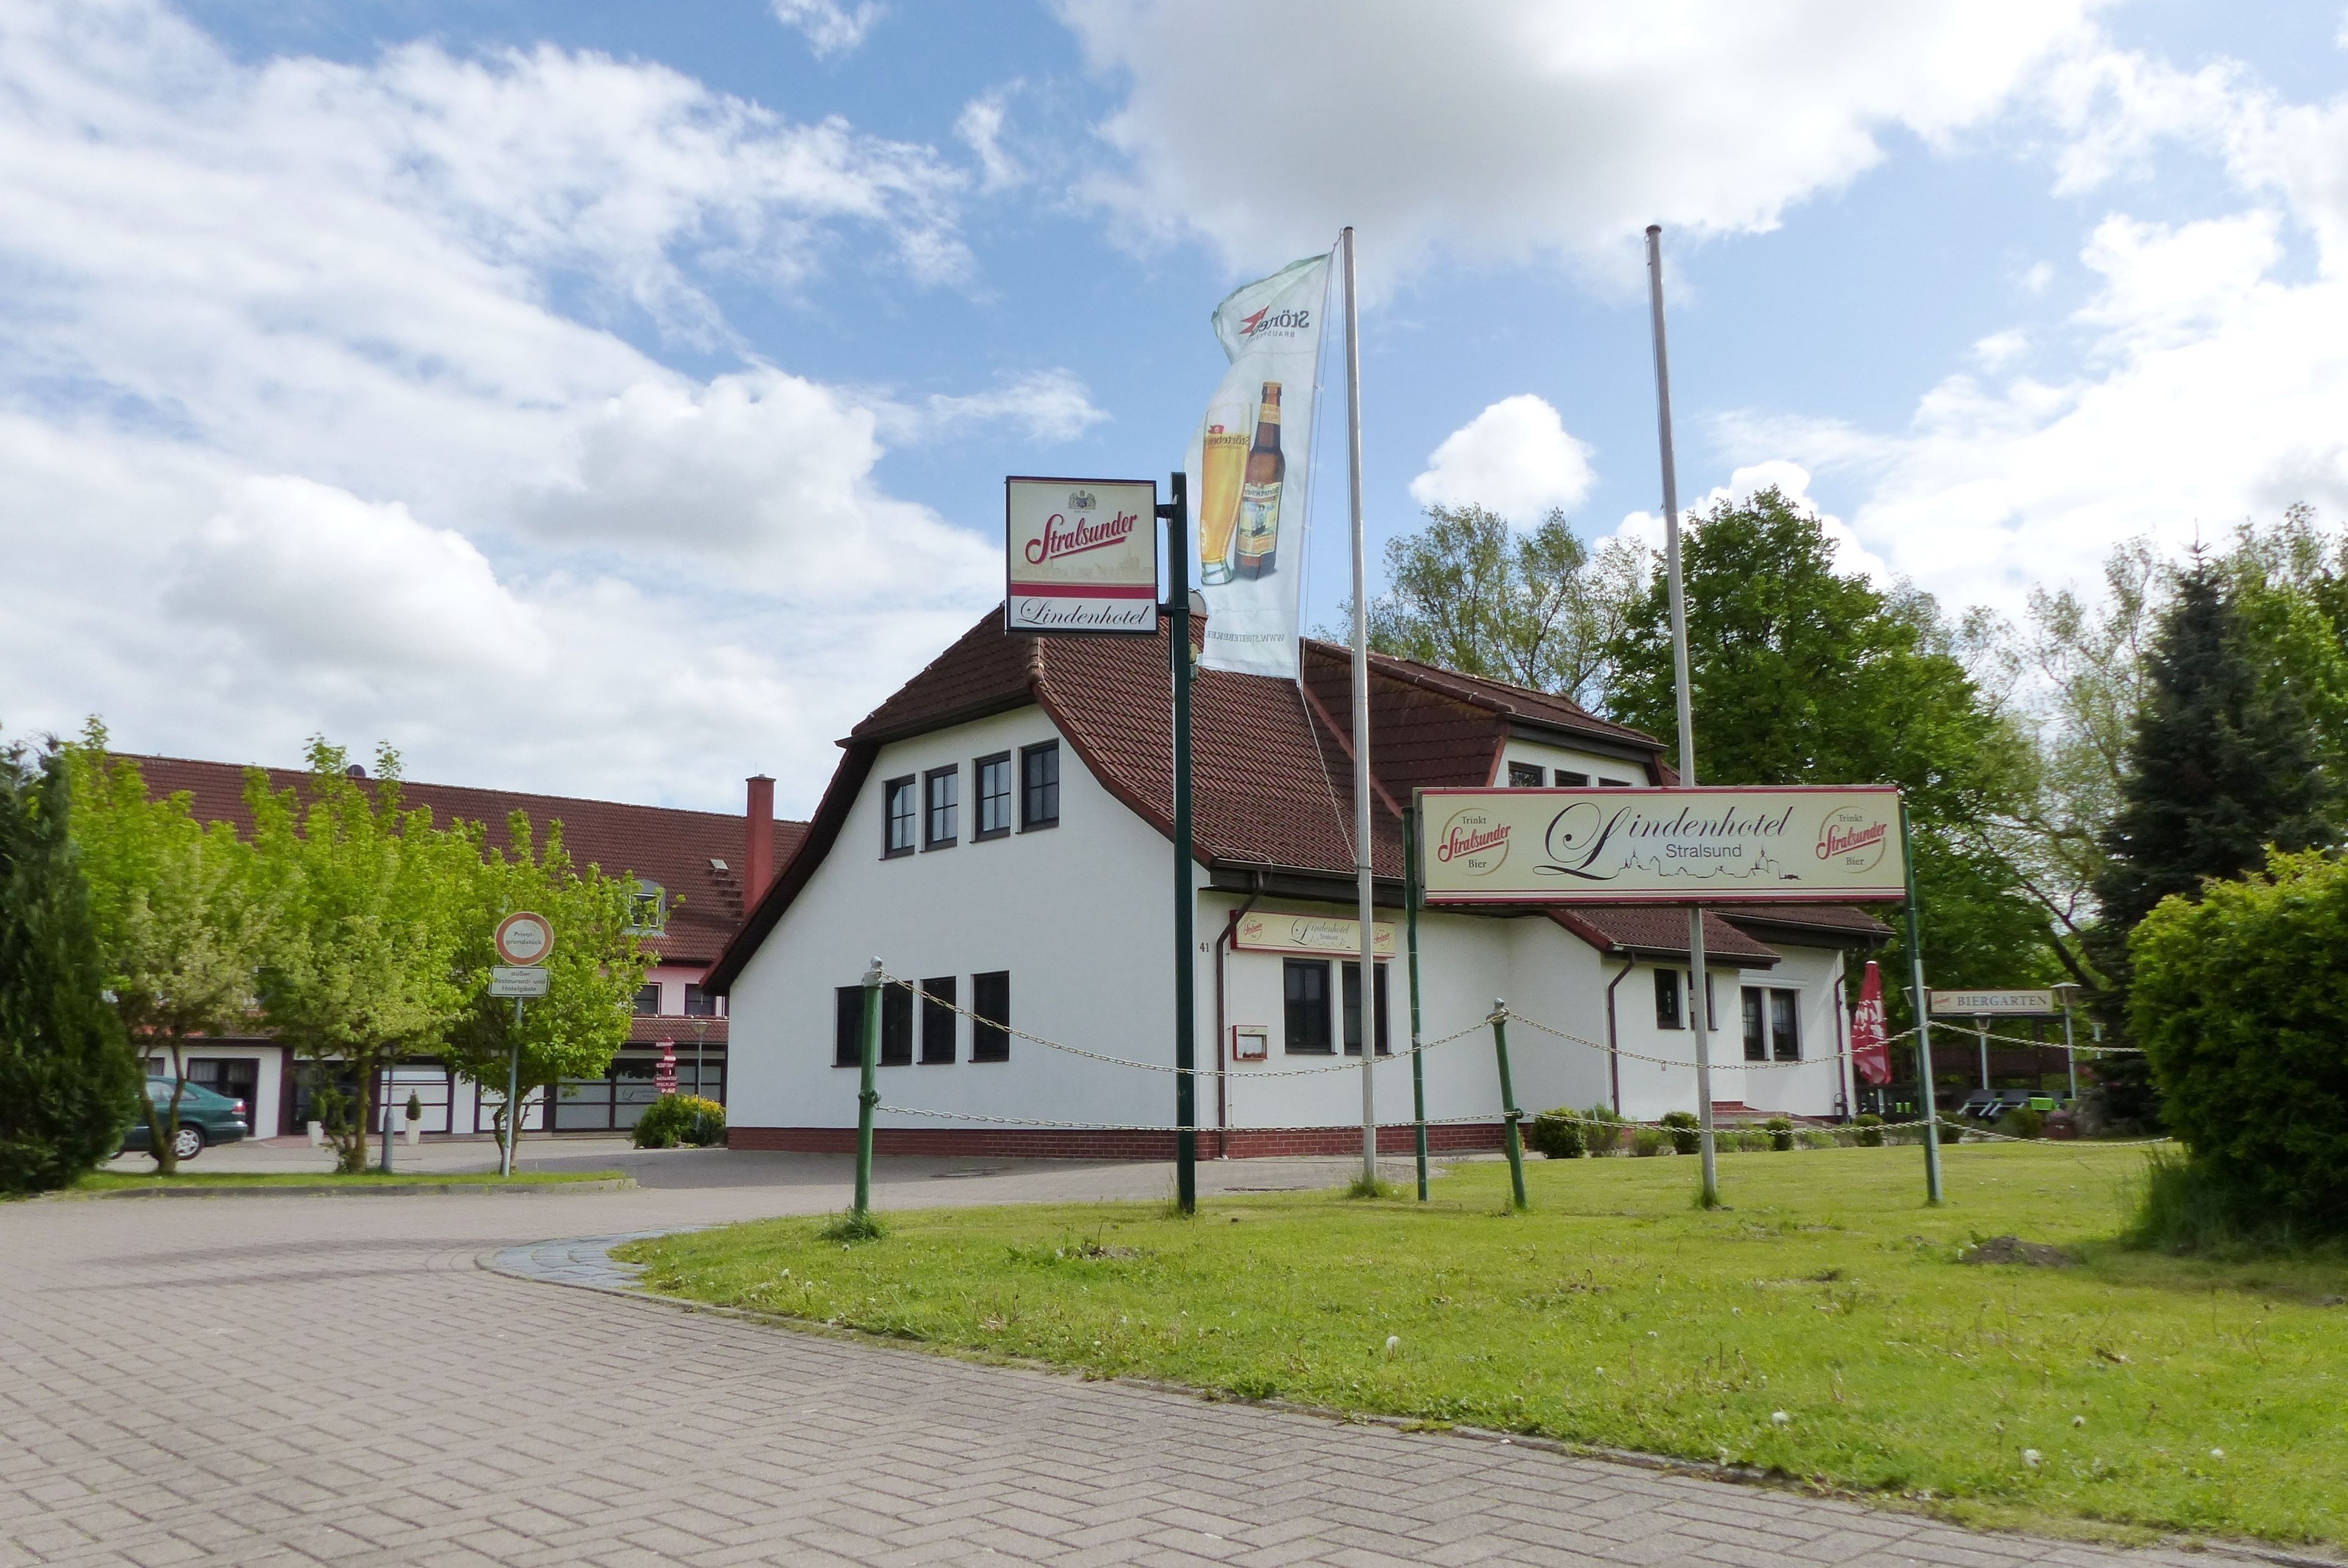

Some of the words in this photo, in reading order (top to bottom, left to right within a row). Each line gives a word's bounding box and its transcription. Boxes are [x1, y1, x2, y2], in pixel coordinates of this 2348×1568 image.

[1025, 511, 1138, 565] Stralsunder
[1016, 597, 1150, 625] Lindenhotel
[1461, 815, 1487, 825] Trinkt
[1837, 814, 1863, 822] Trinkt
[1438, 823, 1512, 863] Stralsunder
[1532, 802, 1794, 881] Lindenhotel
[1815, 820, 1888, 860] Stralsunder
[1665, 844, 1742, 859] Stralsund
[1468, 859, 1487, 868] Bier
[1845, 856, 1864, 866] Bier
[1199, 941, 1209, 953] 41
[1957, 995, 2048, 1006] BIERGARTEN
